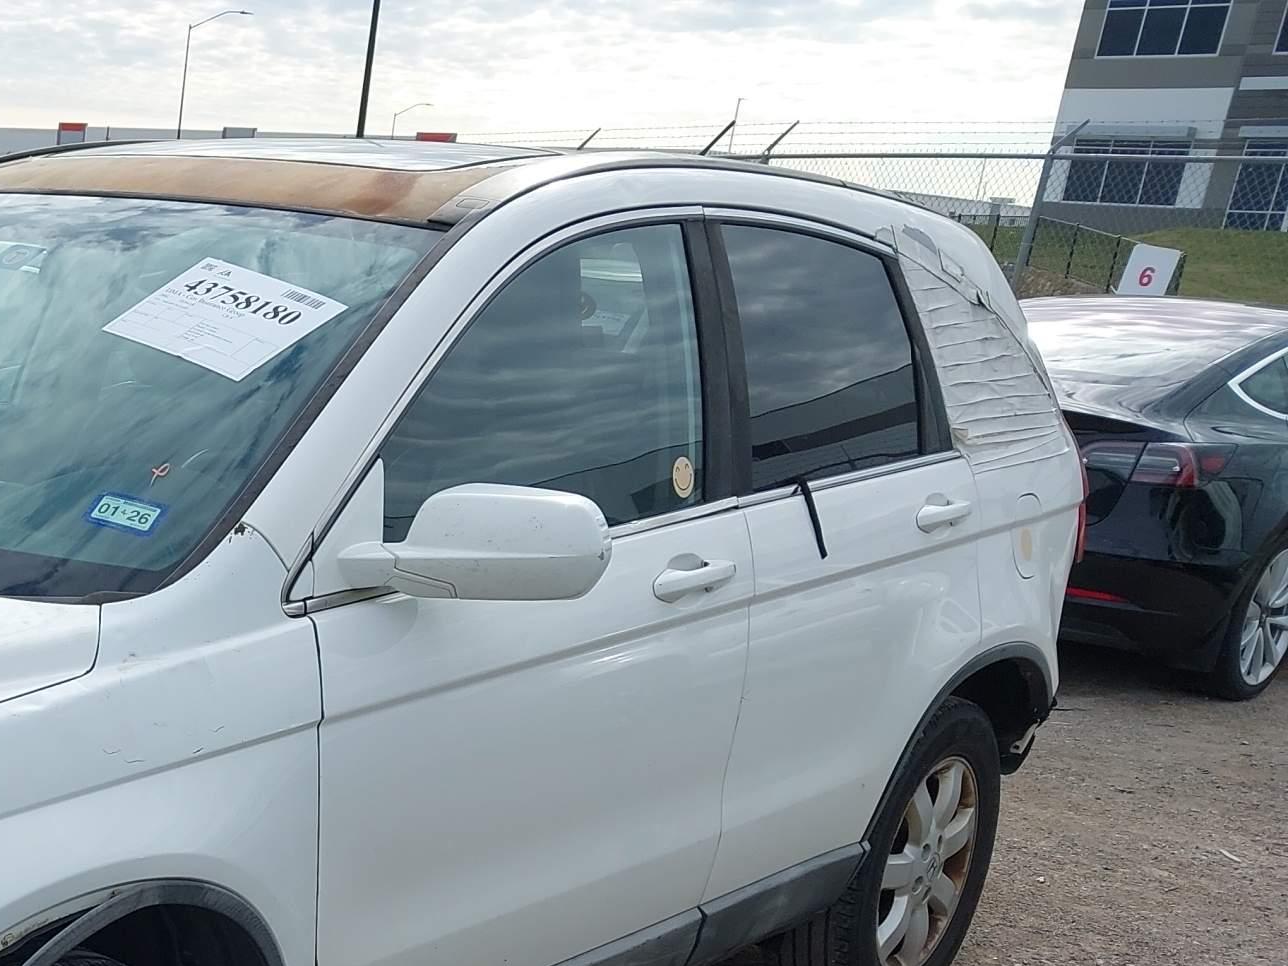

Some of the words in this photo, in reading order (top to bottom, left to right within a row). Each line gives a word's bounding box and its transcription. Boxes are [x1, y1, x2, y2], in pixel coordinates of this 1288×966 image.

[1138, 266, 1155, 287] 6
[184, 279, 302, 325] 43758180
[97, 502, 121, 517] 01
[126, 510, 151, 525] 26
